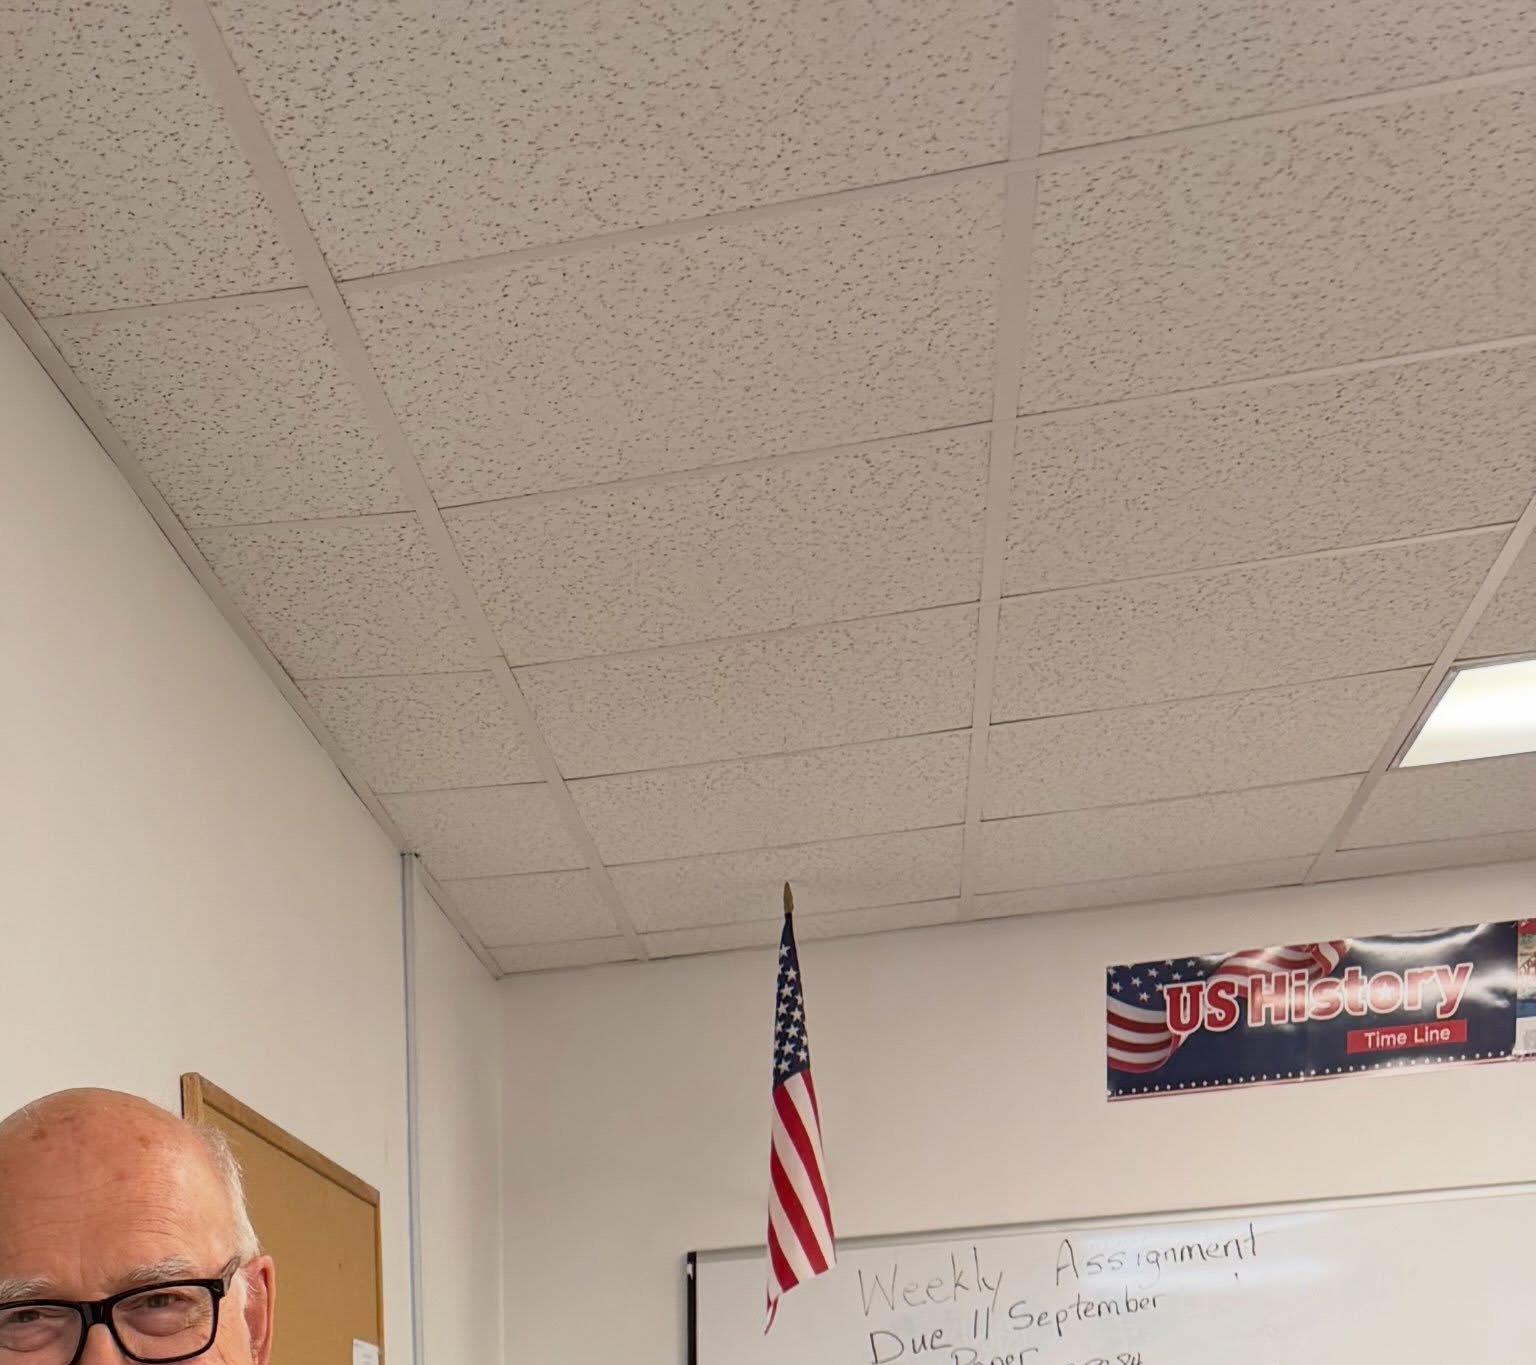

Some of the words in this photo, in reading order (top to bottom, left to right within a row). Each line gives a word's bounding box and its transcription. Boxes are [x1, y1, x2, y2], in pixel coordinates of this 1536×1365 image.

[1165, 978, 1240, 1034] US
[1246, 962, 1474, 1027] History
[1364, 1031, 1407, 1050] Time
[1414, 1027, 1451, 1045] Line
[857, 1245, 1003, 1316] Weekly
[1056, 1222, 1264, 1289] Assignment
[869, 1328, 953, 1365] Due
[1008, 1283, 1166, 1337] September
